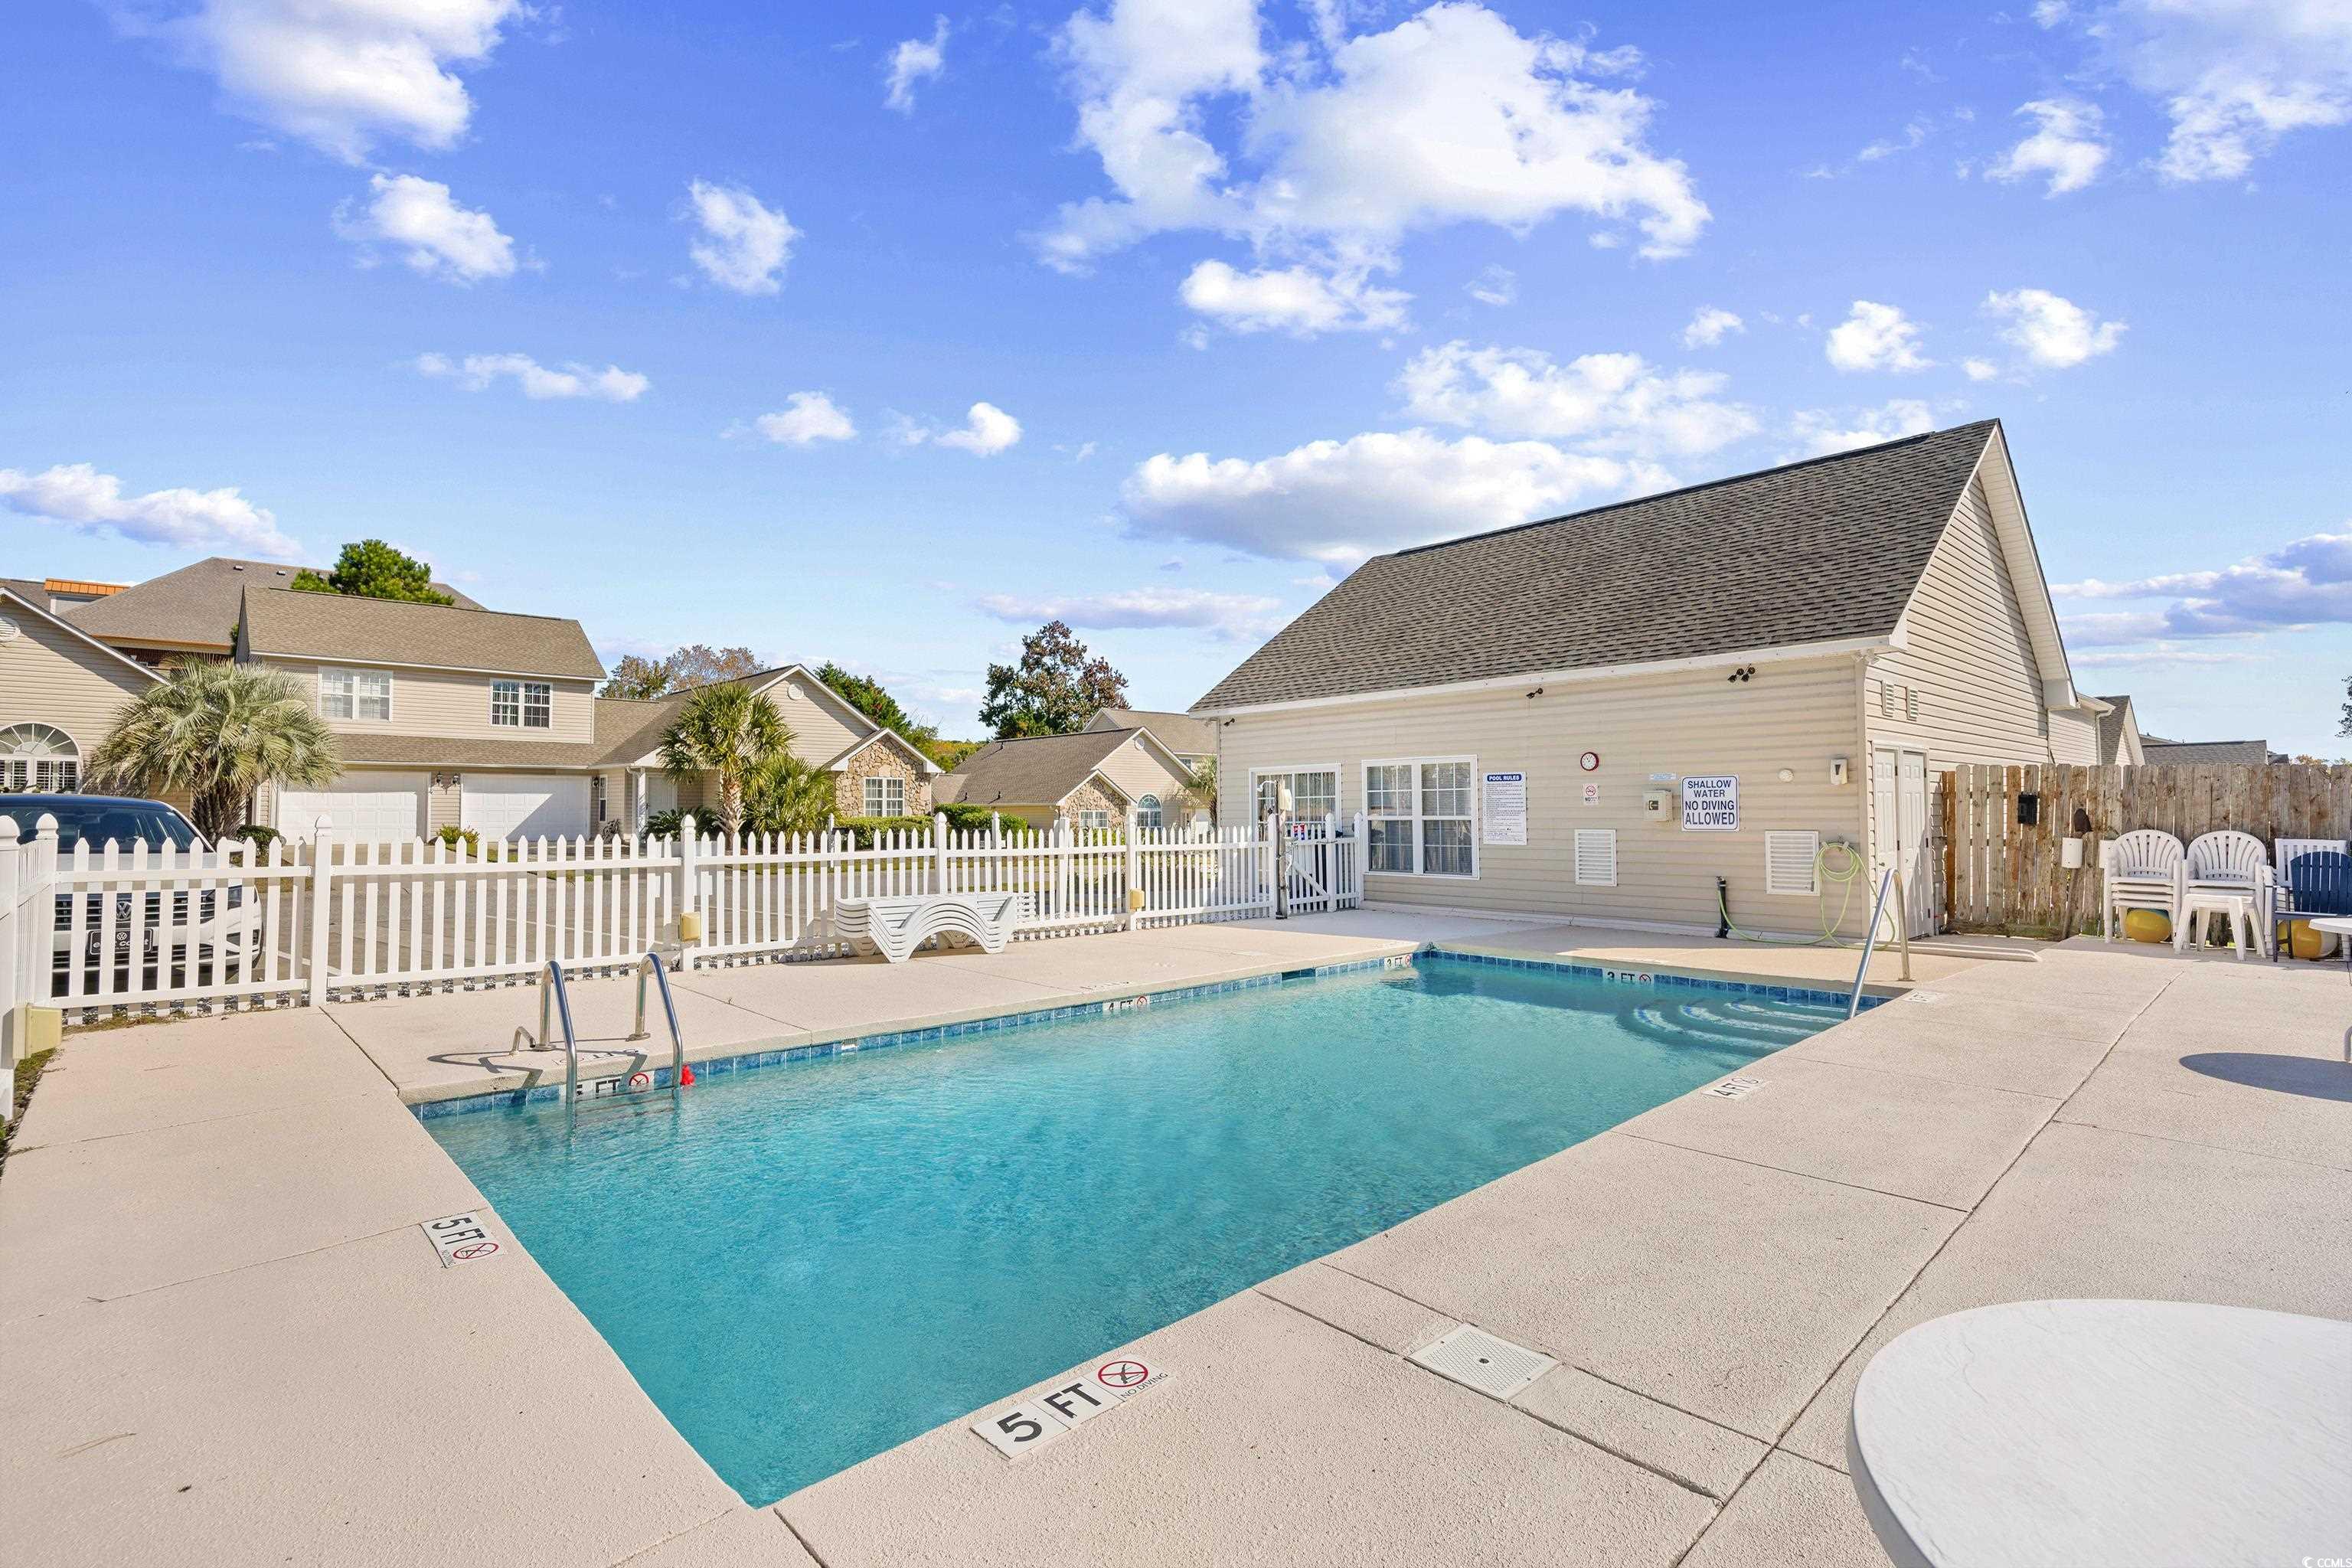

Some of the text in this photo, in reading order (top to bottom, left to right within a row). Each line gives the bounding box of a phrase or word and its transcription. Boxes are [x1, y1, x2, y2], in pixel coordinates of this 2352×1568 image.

[1687, 780, 1731, 789] SHALLOW
[1685, 800, 1735, 810] NO DIVING
[1685, 812, 1735, 825] ALLOWED
[432, 1217, 485, 1245] 5 FT
[1120, 1372, 1169, 1399] NO DIVING
[996, 1382, 1102, 1442] 5 FT
